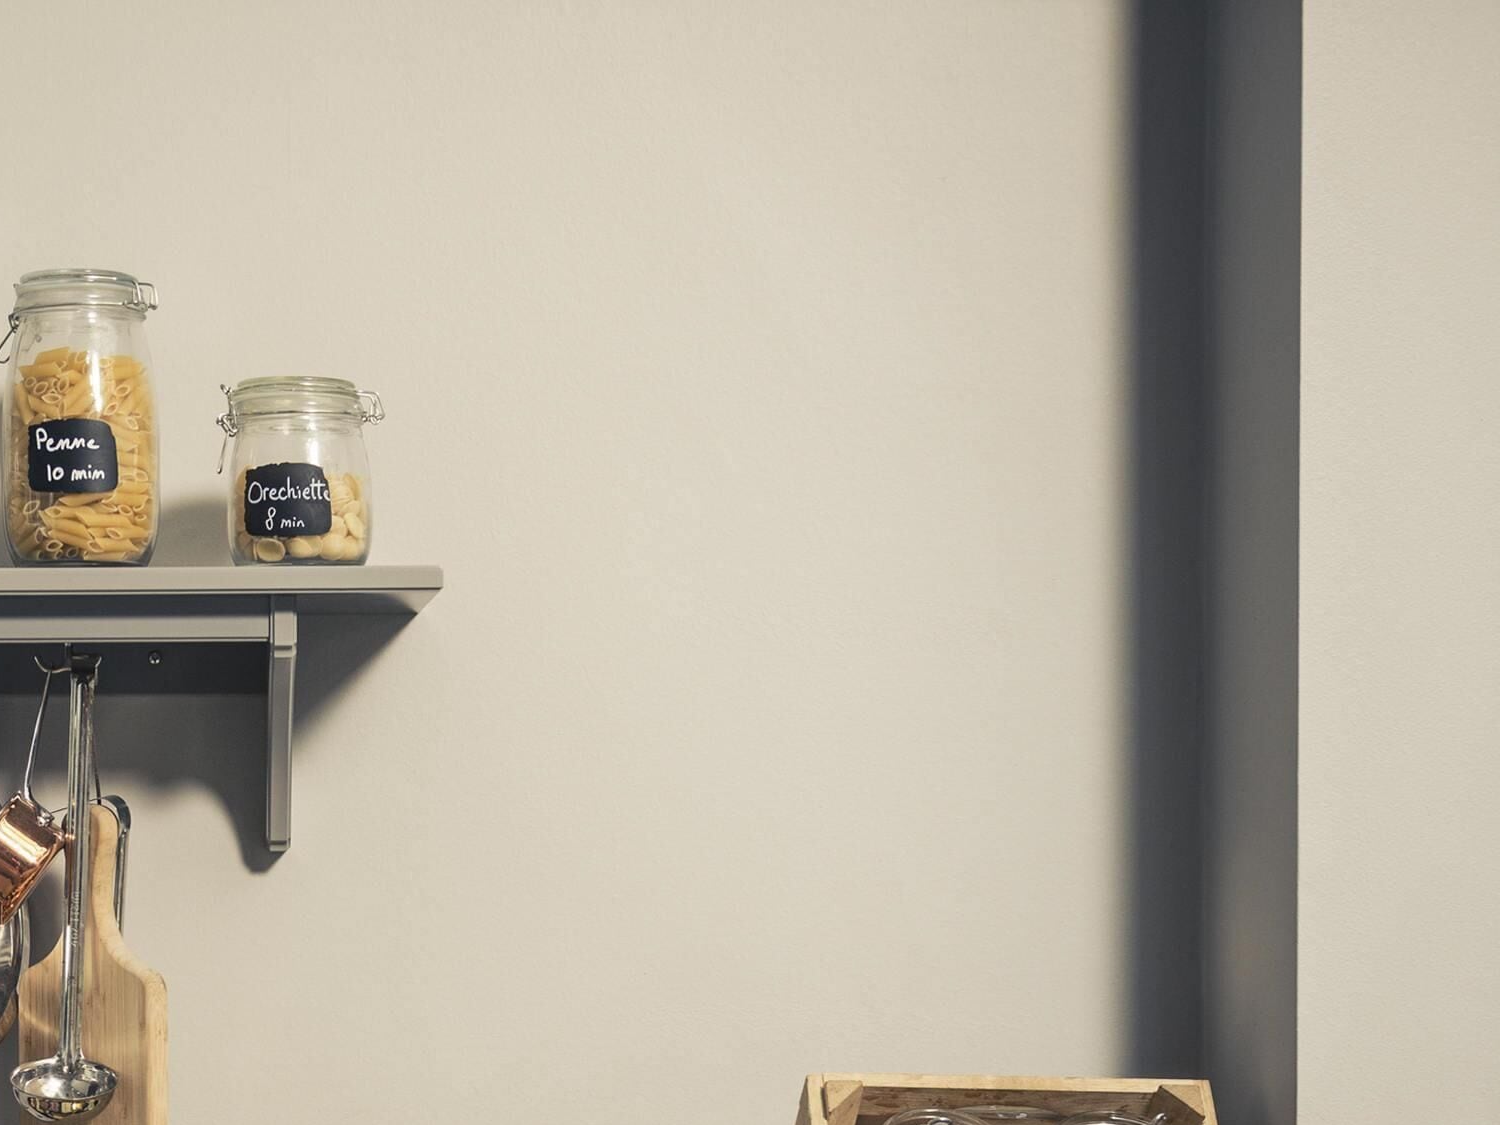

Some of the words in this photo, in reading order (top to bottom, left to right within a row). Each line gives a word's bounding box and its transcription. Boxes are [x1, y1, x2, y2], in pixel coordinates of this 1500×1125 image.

[35, 427, 100, 452] Penne
[46, 463, 65, 482] 10
[71, 463, 105, 481] min
[247, 476, 332, 504] Orechiette
[265, 506, 277, 531] 8
[280, 516, 305, 529] min
